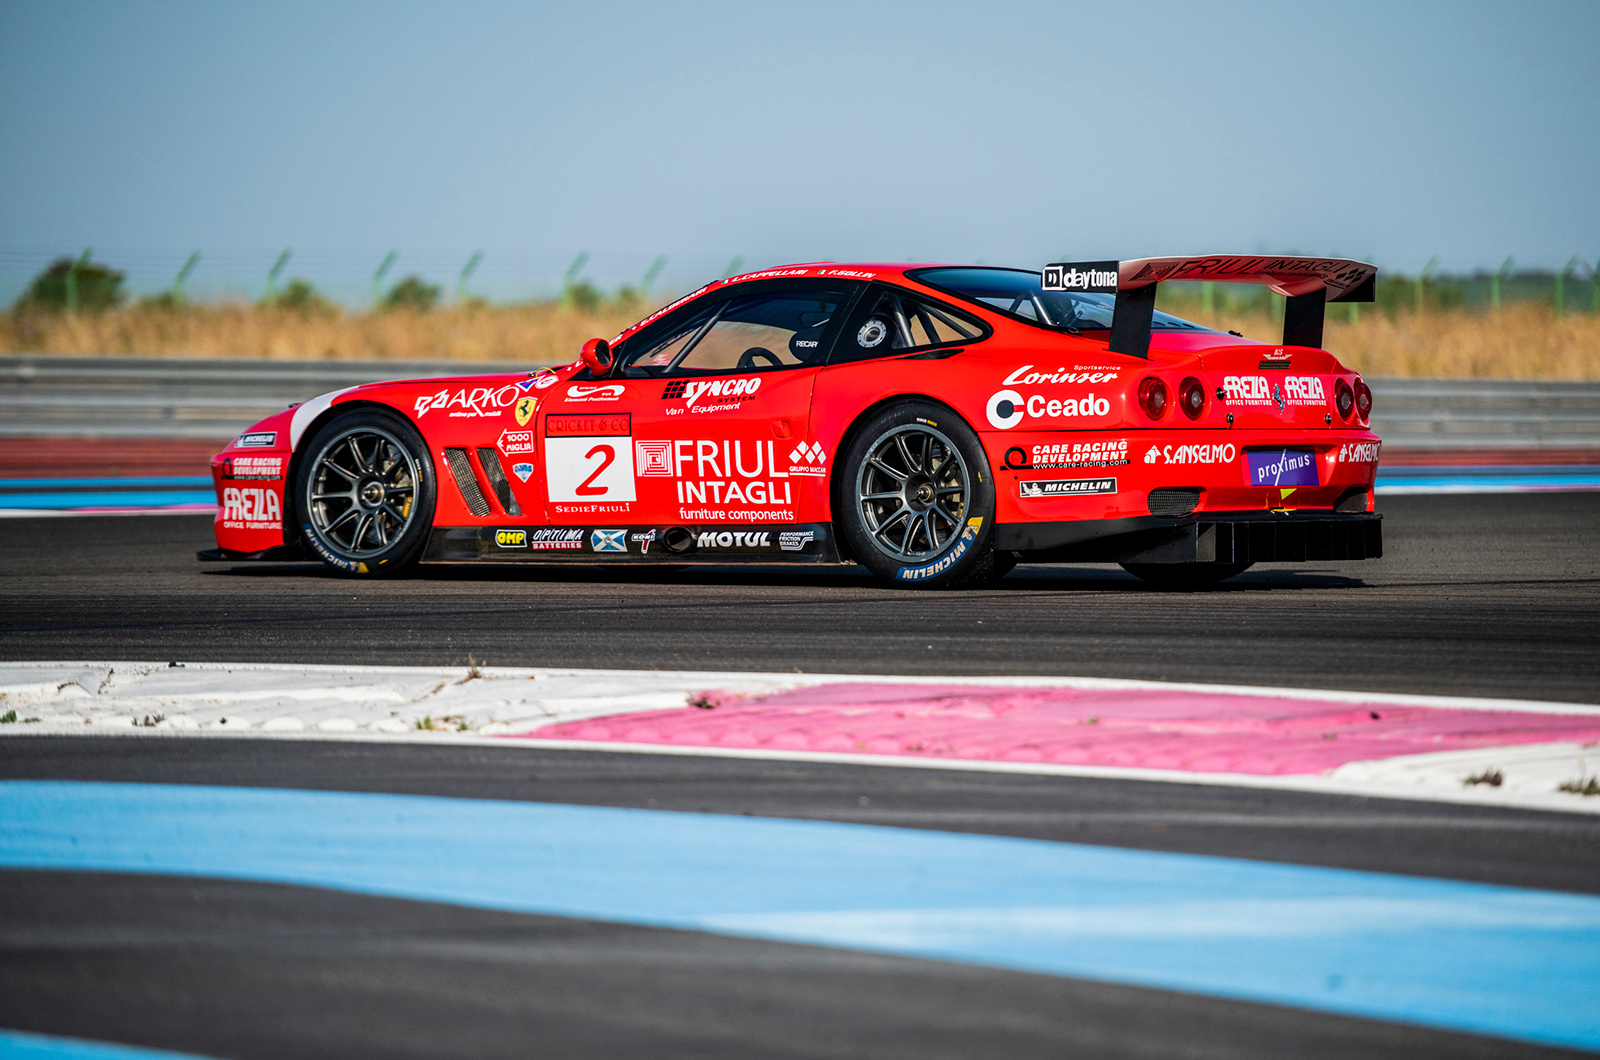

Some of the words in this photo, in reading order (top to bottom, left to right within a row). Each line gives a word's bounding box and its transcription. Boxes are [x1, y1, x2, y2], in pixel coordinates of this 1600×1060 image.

[1167, 258, 1264, 279] FRIUL
[1263, 260, 1350, 273] INTAGLI
[1063, 268, 1118, 289] daytona
[796, 340, 819, 348] RECAR
[1002, 365, 1118, 386] Lorinser
[682, 377, 762, 408] SYNCRO
[717, 395, 756, 403] SYSTEM
[665, 407, 684, 416] Van
[691, 402, 741, 414] Equipment
[1027, 393, 1110, 418] Ceado
[547, 419, 595, 432] CRICKET
[611, 418, 629, 431] CO
[244, 434, 275, 443] MICHELIN
[506, 433, 530, 442] 1000
[506, 442, 532, 452] MIGLIA
[1032, 444, 1068, 454] CARE
[1072, 441, 1128, 453] RACING
[1163, 443, 1236, 464] S.ANSELMO
[233, 457, 252, 466] CARE
[252, 457, 282, 466] RACING
[674, 440, 789, 478] FRIUL
[1032, 450, 1128, 464] DEVELOPMENT
[233, 466, 282, 475] DEVELOPMENT
[575, 444, 616, 496] 2
[1032, 459, 1128, 470] www.care-racing.com
[1257, 449, 1311, 486] proximus
[676, 481, 792, 504] INTAGLI
[1044, 481, 1112, 492] MICHELIN
[679, 507, 726, 520] furniture
[728, 509, 794, 522] components
[223, 521, 244, 529] OFFICE
[246, 522, 283, 530] FURNITURE
[497, 531, 525, 545] OMP
[696, 531, 771, 547] MOTUL
[305, 528, 349, 569] MICHELIN
[902, 540, 966, 579] MICHELIN
